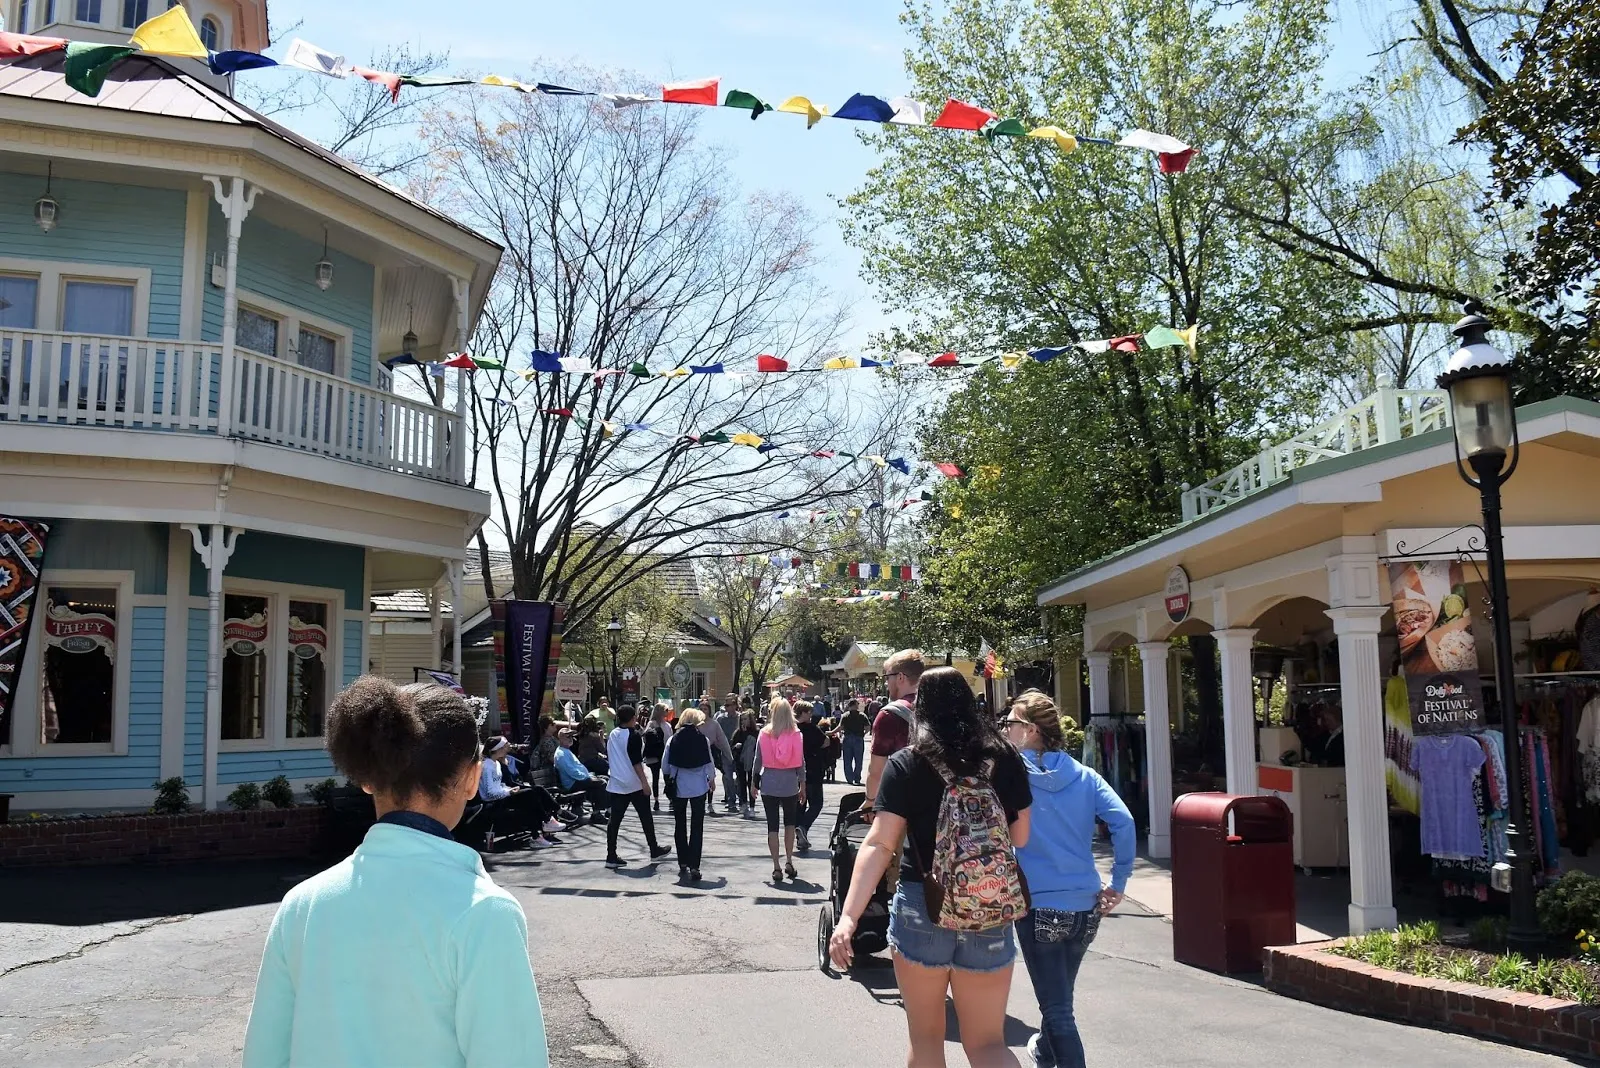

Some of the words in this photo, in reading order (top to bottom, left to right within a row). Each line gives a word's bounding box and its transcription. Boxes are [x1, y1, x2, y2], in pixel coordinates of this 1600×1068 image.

[52, 621, 105, 636] TAFFY
[521, 623, 535, 673] FESTIVAL
[522, 680, 531, 695] OF
[1424, 699, 1469, 711] FESTIVAL
[1417, 713, 1431, 724] OF
[968, 881, 988, 894] Hard
[988, 876, 1007, 890] Rock
